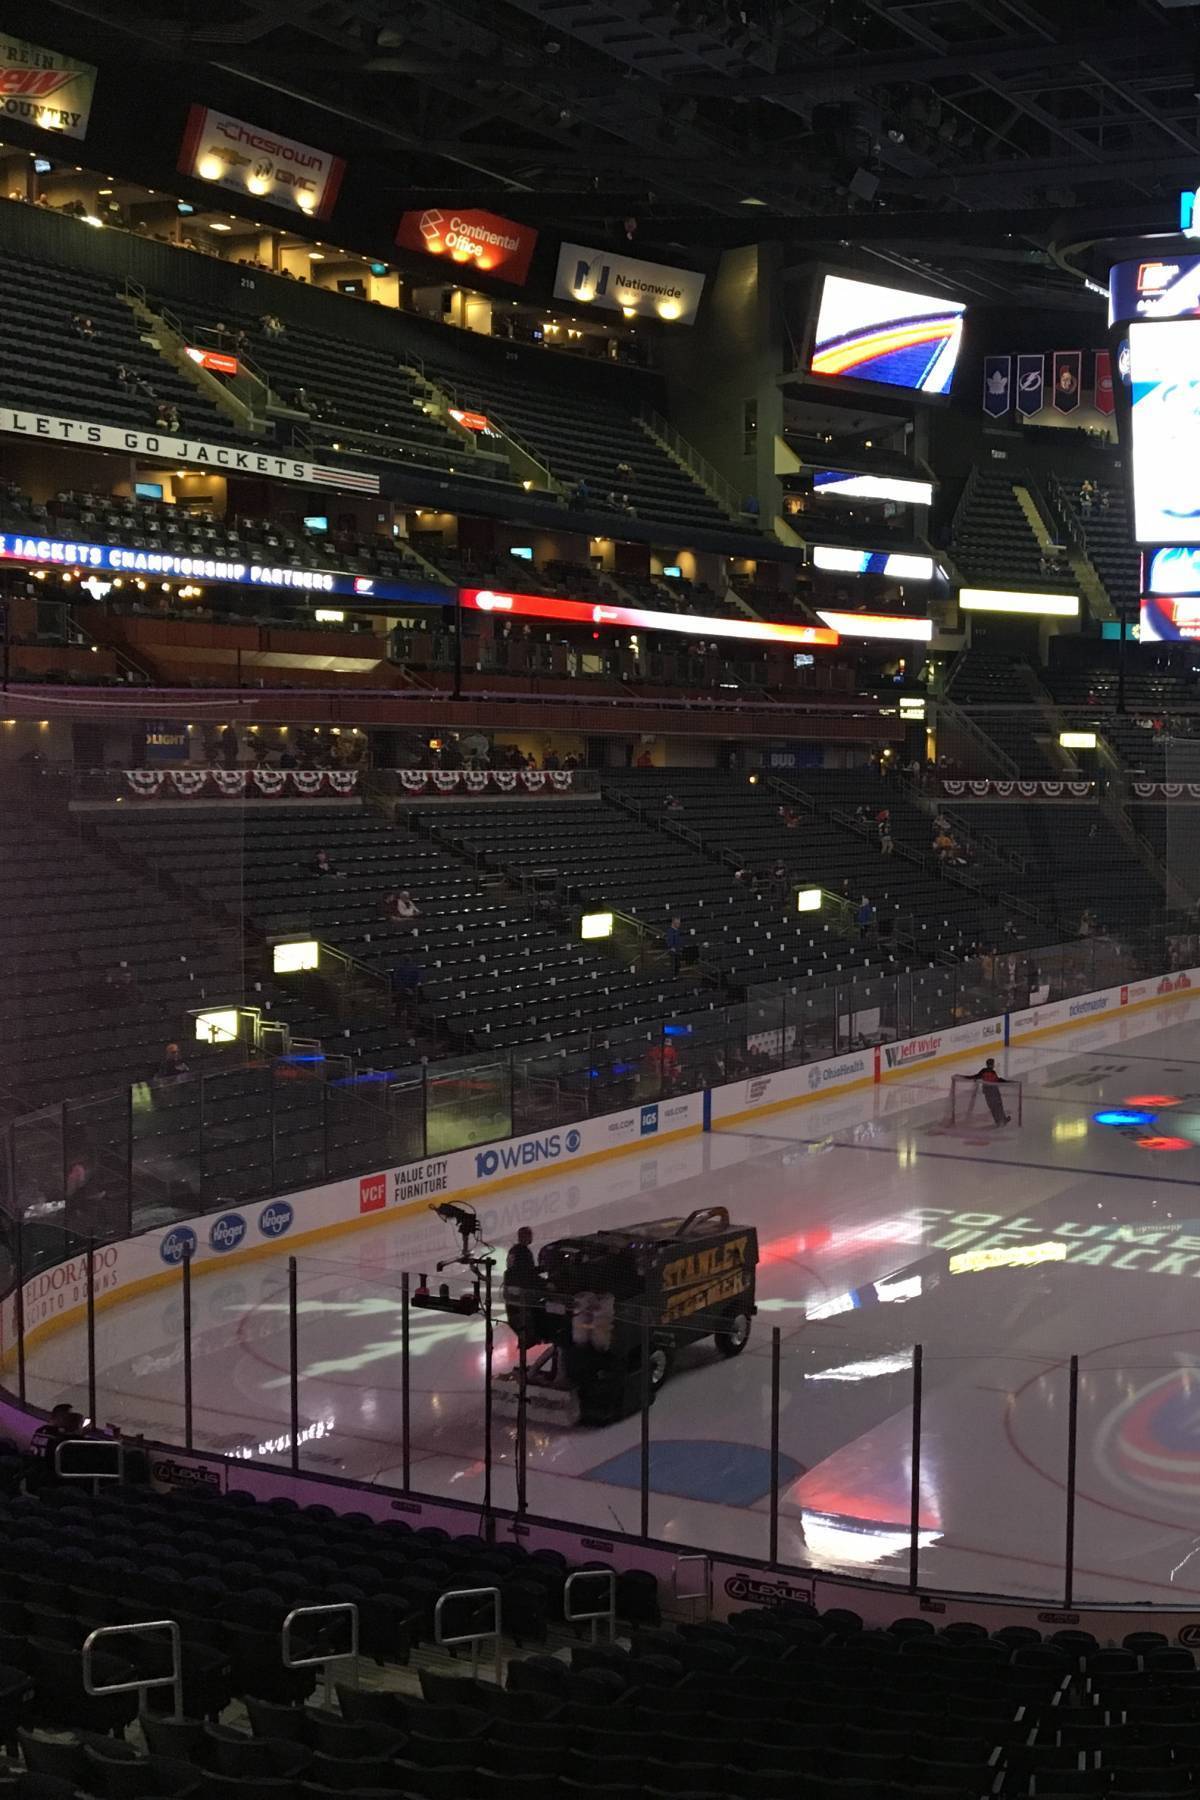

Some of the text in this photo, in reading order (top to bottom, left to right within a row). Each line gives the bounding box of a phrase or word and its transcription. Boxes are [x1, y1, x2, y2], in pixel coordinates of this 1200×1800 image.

[34, 52, 55, 68] IN
[444, 232, 484, 257] Office
[450, 216, 520, 252] Continental
[615, 273, 683, 299] Nationwide
[12, 413, 306, 478] LET'S GO JACKETS
[13, 538, 333, 591] JACKETS CHAMPIONSHIP PARTNERS
[771, 753, 796, 767] BUD
[900, 1043, 917, 1059] Jeff
[642, 1112, 657, 1127] IGS
[394, 1160, 449, 1185] VALUE CITY
[361, 1185, 385, 1203] VCF
[394, 1176, 448, 1202] FURNITURE
[214, 1220, 243, 1246] Kroger
[263, 1208, 290, 1233] Kroger
[662, 1236, 748, 1290] STANLEY
[747, 1581, 809, 1603] LEXUS
